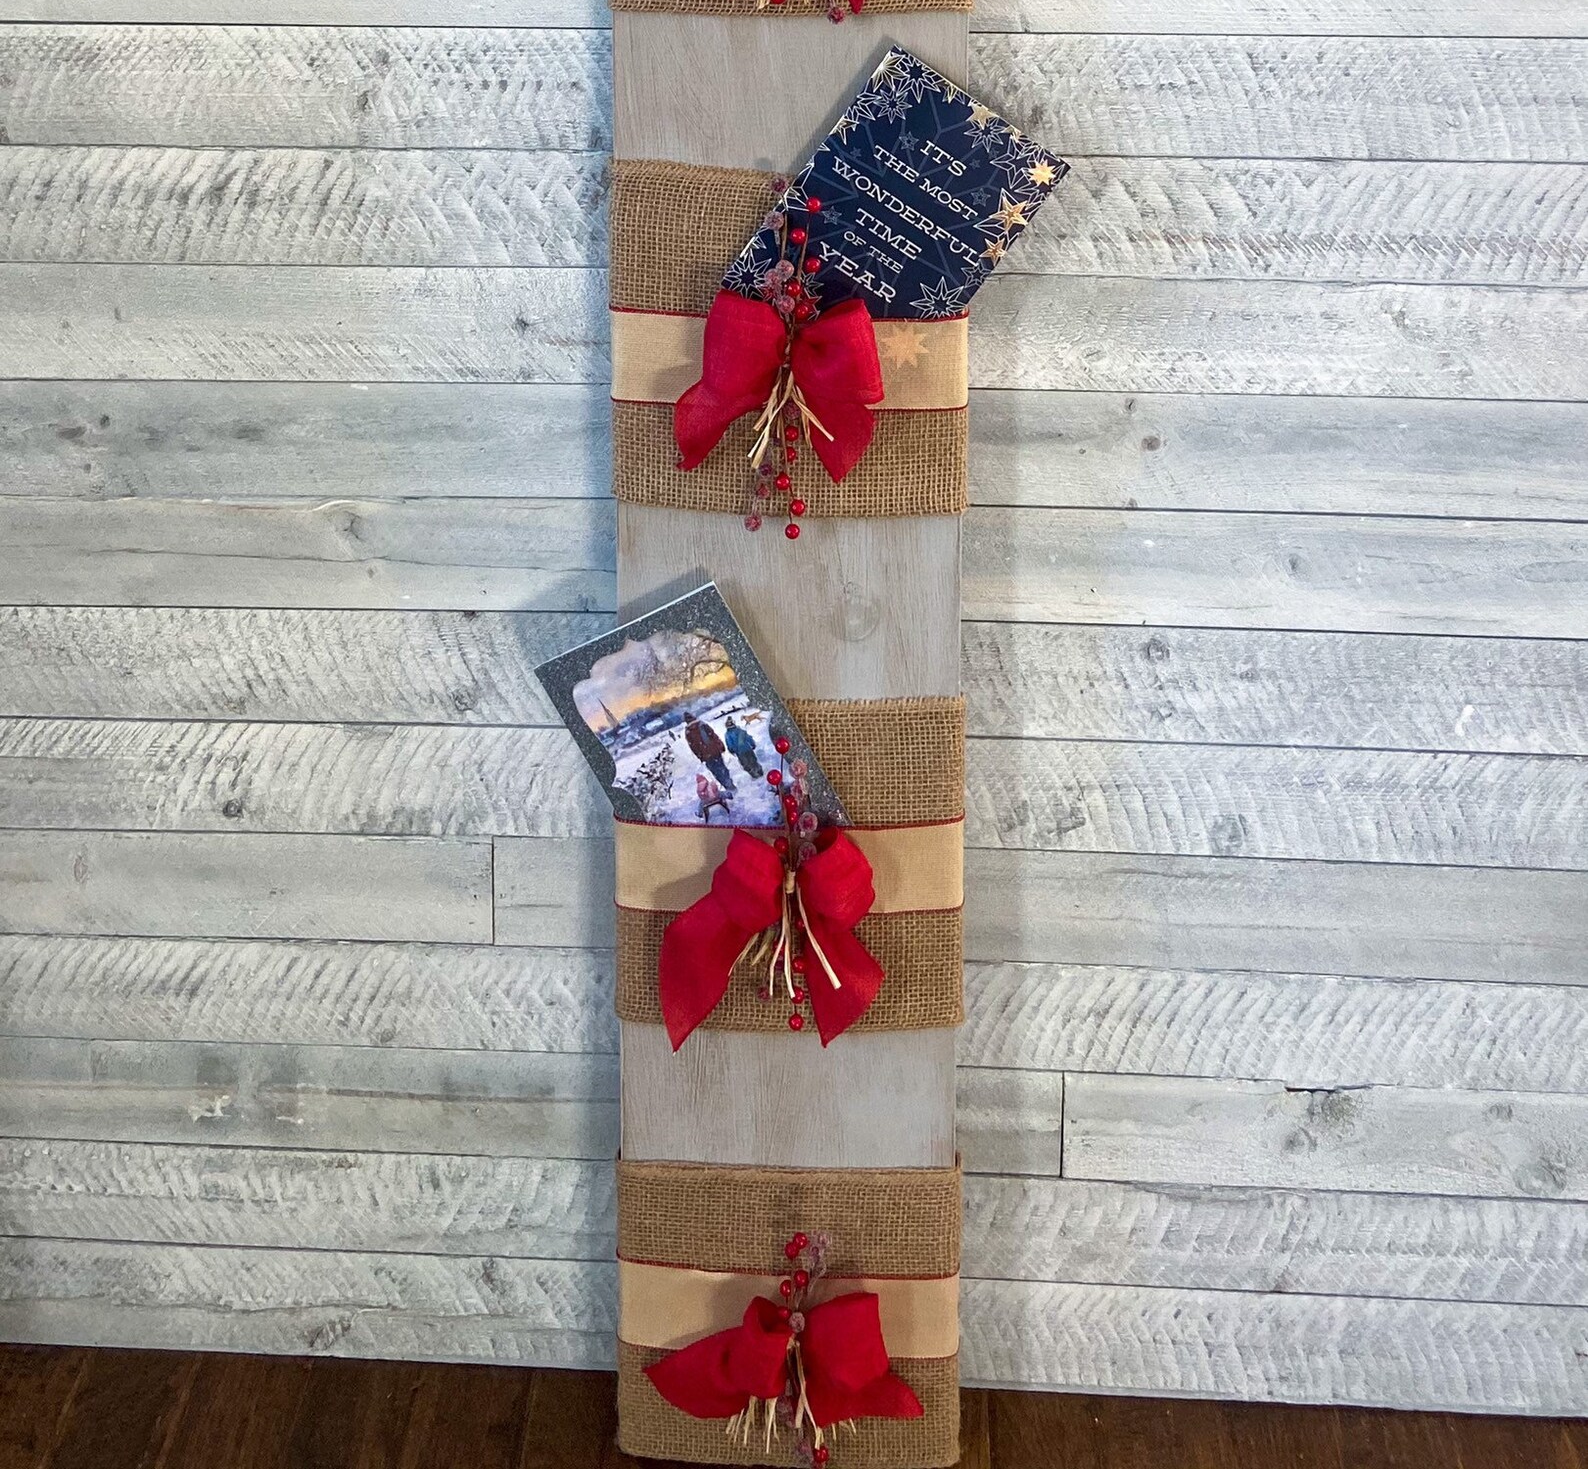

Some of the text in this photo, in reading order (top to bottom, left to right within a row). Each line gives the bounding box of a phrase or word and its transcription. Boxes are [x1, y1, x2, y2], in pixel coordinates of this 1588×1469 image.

[873, 145, 978, 221] THE MOST
[920, 140, 967, 177] IT'S
[832, 156, 980, 267] WONDERFUL
[855, 208, 922, 260] TIME
[818, 241, 897, 303] YEAR
[843, 231, 903, 274] OF THE
